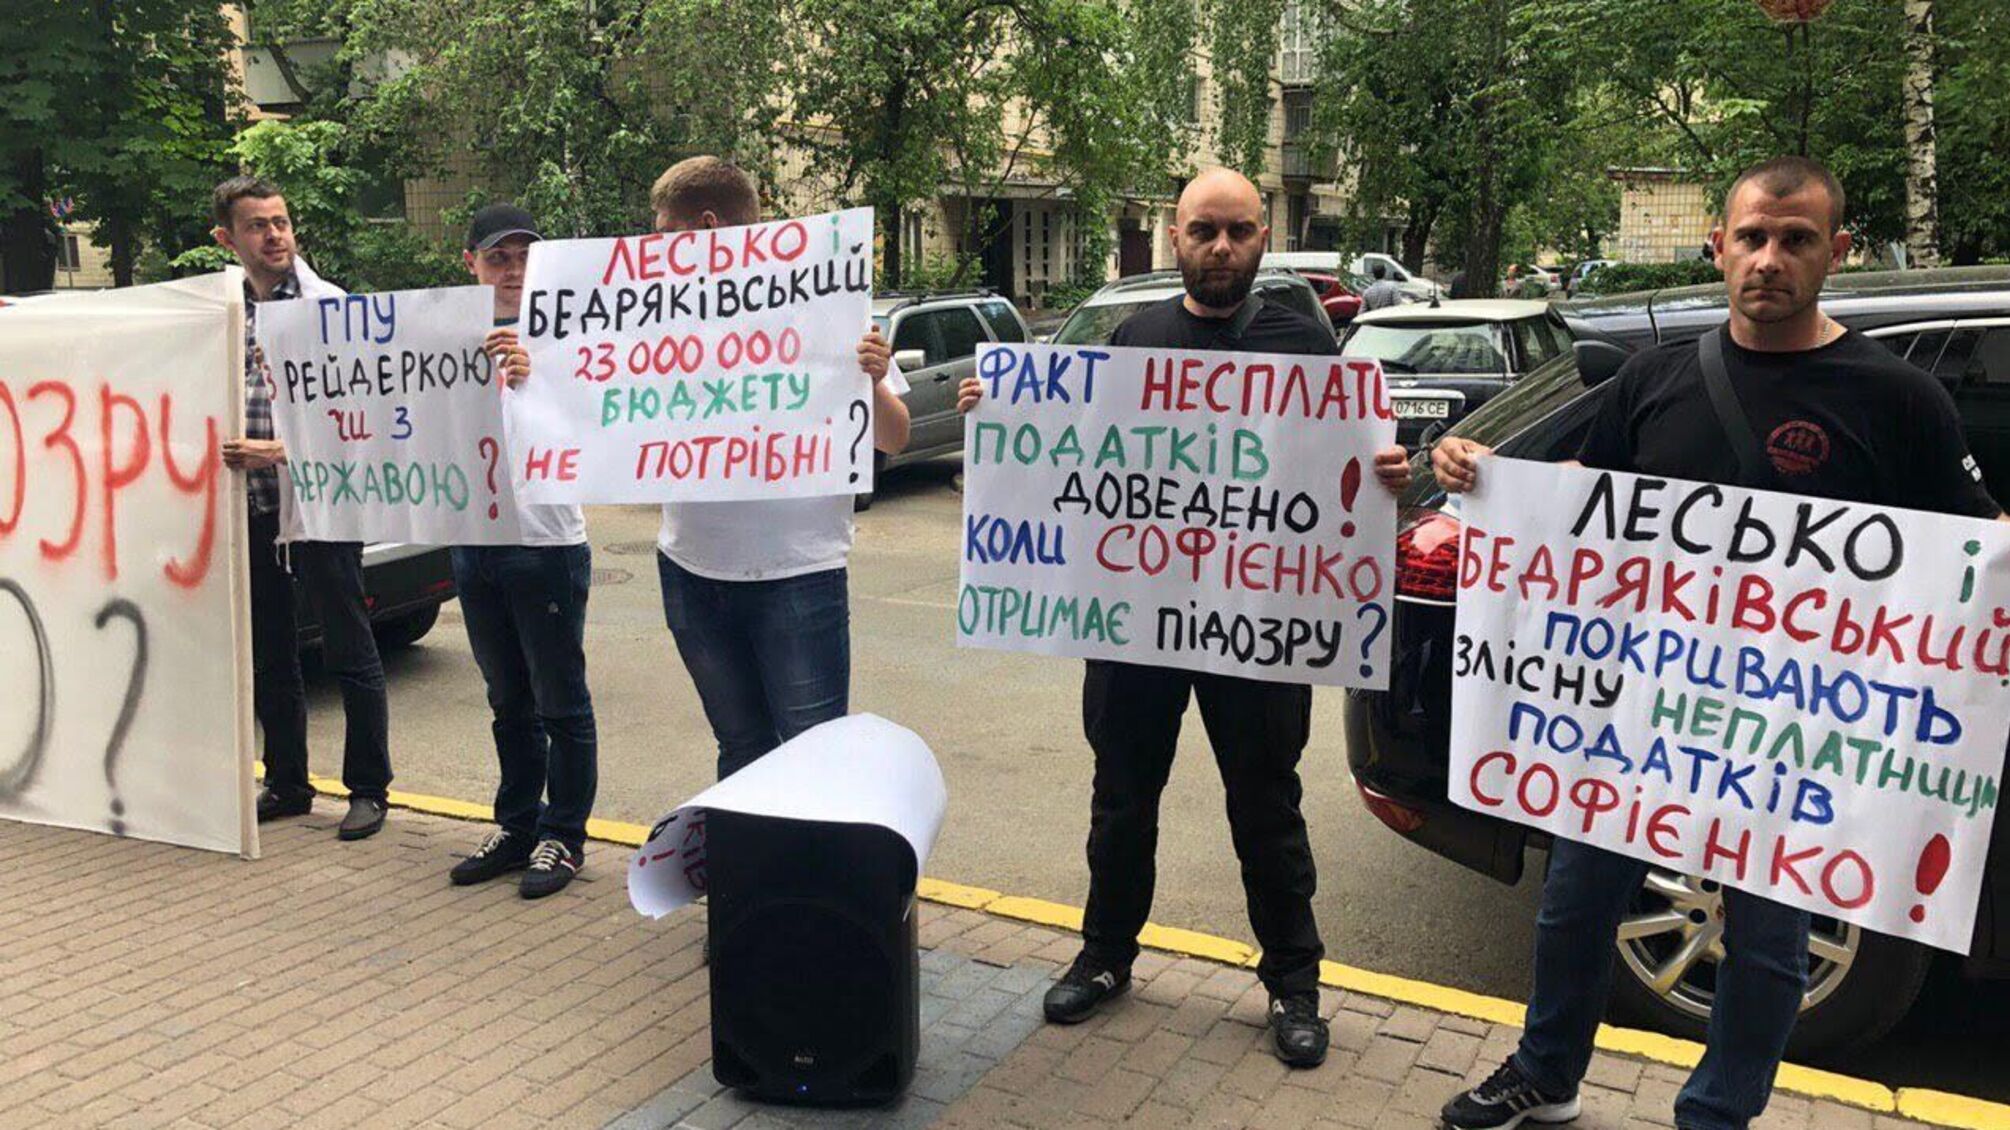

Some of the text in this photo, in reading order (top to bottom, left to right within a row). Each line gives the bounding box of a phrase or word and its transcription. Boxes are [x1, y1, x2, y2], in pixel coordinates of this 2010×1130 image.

[602, 221, 808, 285] ЛЕСЬКО
[318, 294, 396, 344] ГПУ
[284, 347, 493, 404] РЕЙДЕРКОЮ
[575, 327, 801, 381] 23 000 000
[979, 346, 1111, 405] ФАКТ
[601, 373, 811, 427] БЮДЖЕТУ
[1395, 401, 1425, 415] 0716
[525, 446, 581, 481] НЕ
[966, 513, 1066, 566] КОЛИ
[1570, 471, 1902, 581] ЛЕСЬКО
[958, 583, 1132, 646] ОТРИМАЄ
[1544, 611, 1962, 745] ПОКРИВАЮТЬ
